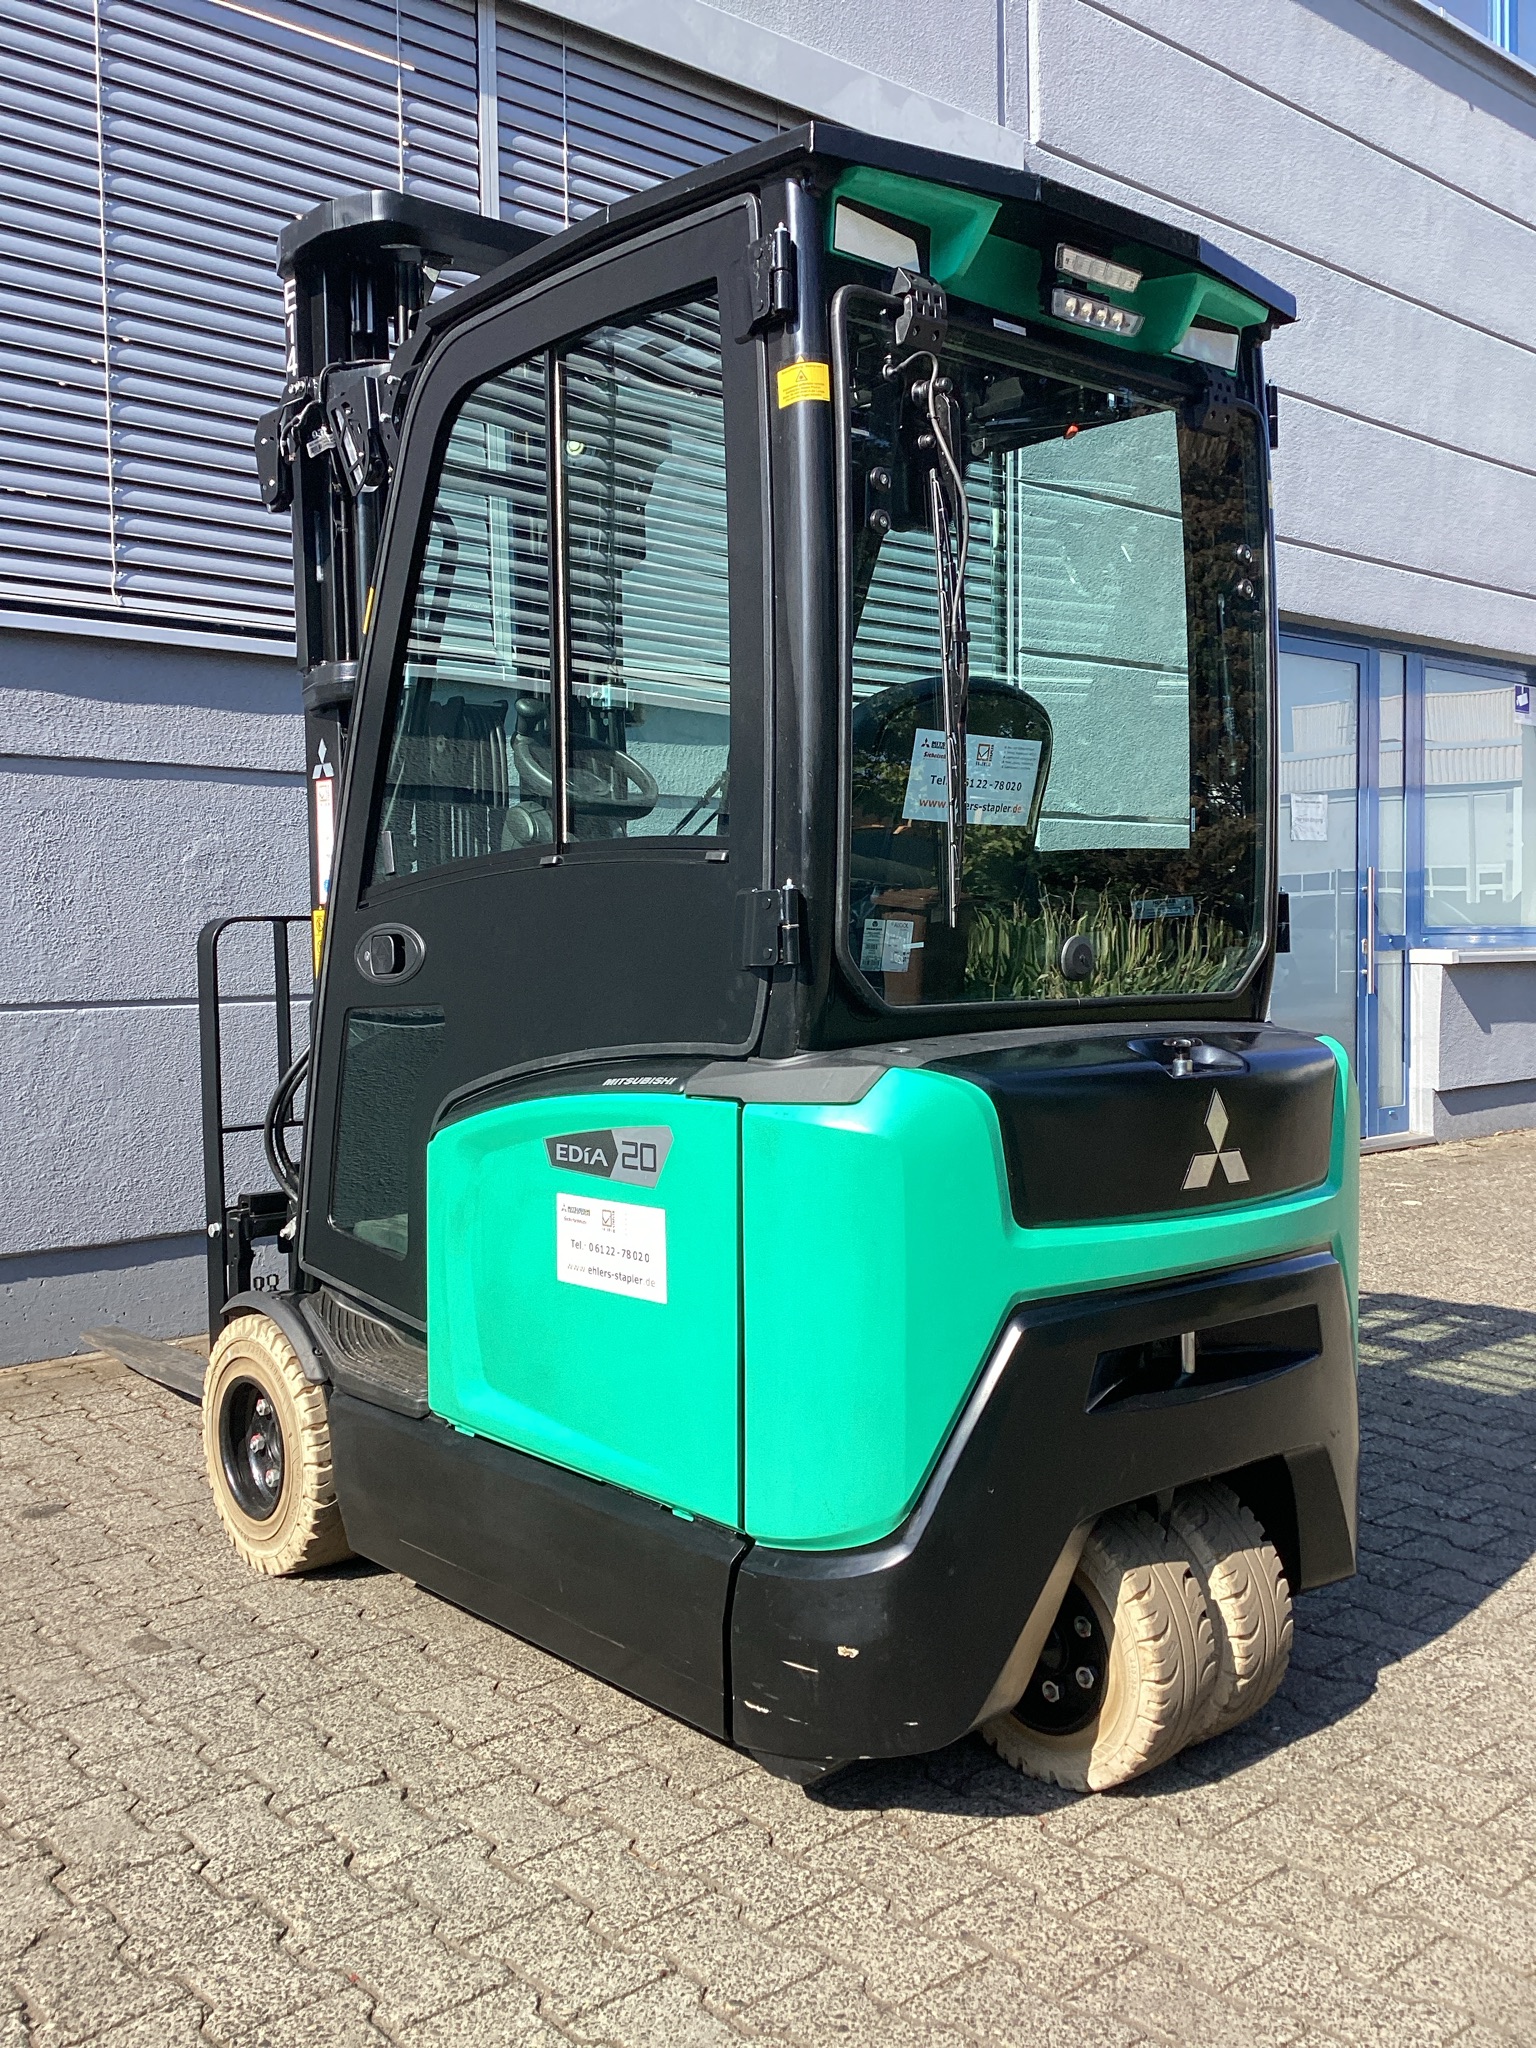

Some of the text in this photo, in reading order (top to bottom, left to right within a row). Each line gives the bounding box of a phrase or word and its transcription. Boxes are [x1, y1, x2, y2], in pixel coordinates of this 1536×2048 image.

[965, 778, 1022, 792] 6122-78020
[602, 1077, 678, 1086] MITSUBISHI
[621, 1140, 657, 1173] 20
[588, 1242, 651, 1263] 06122-78020
